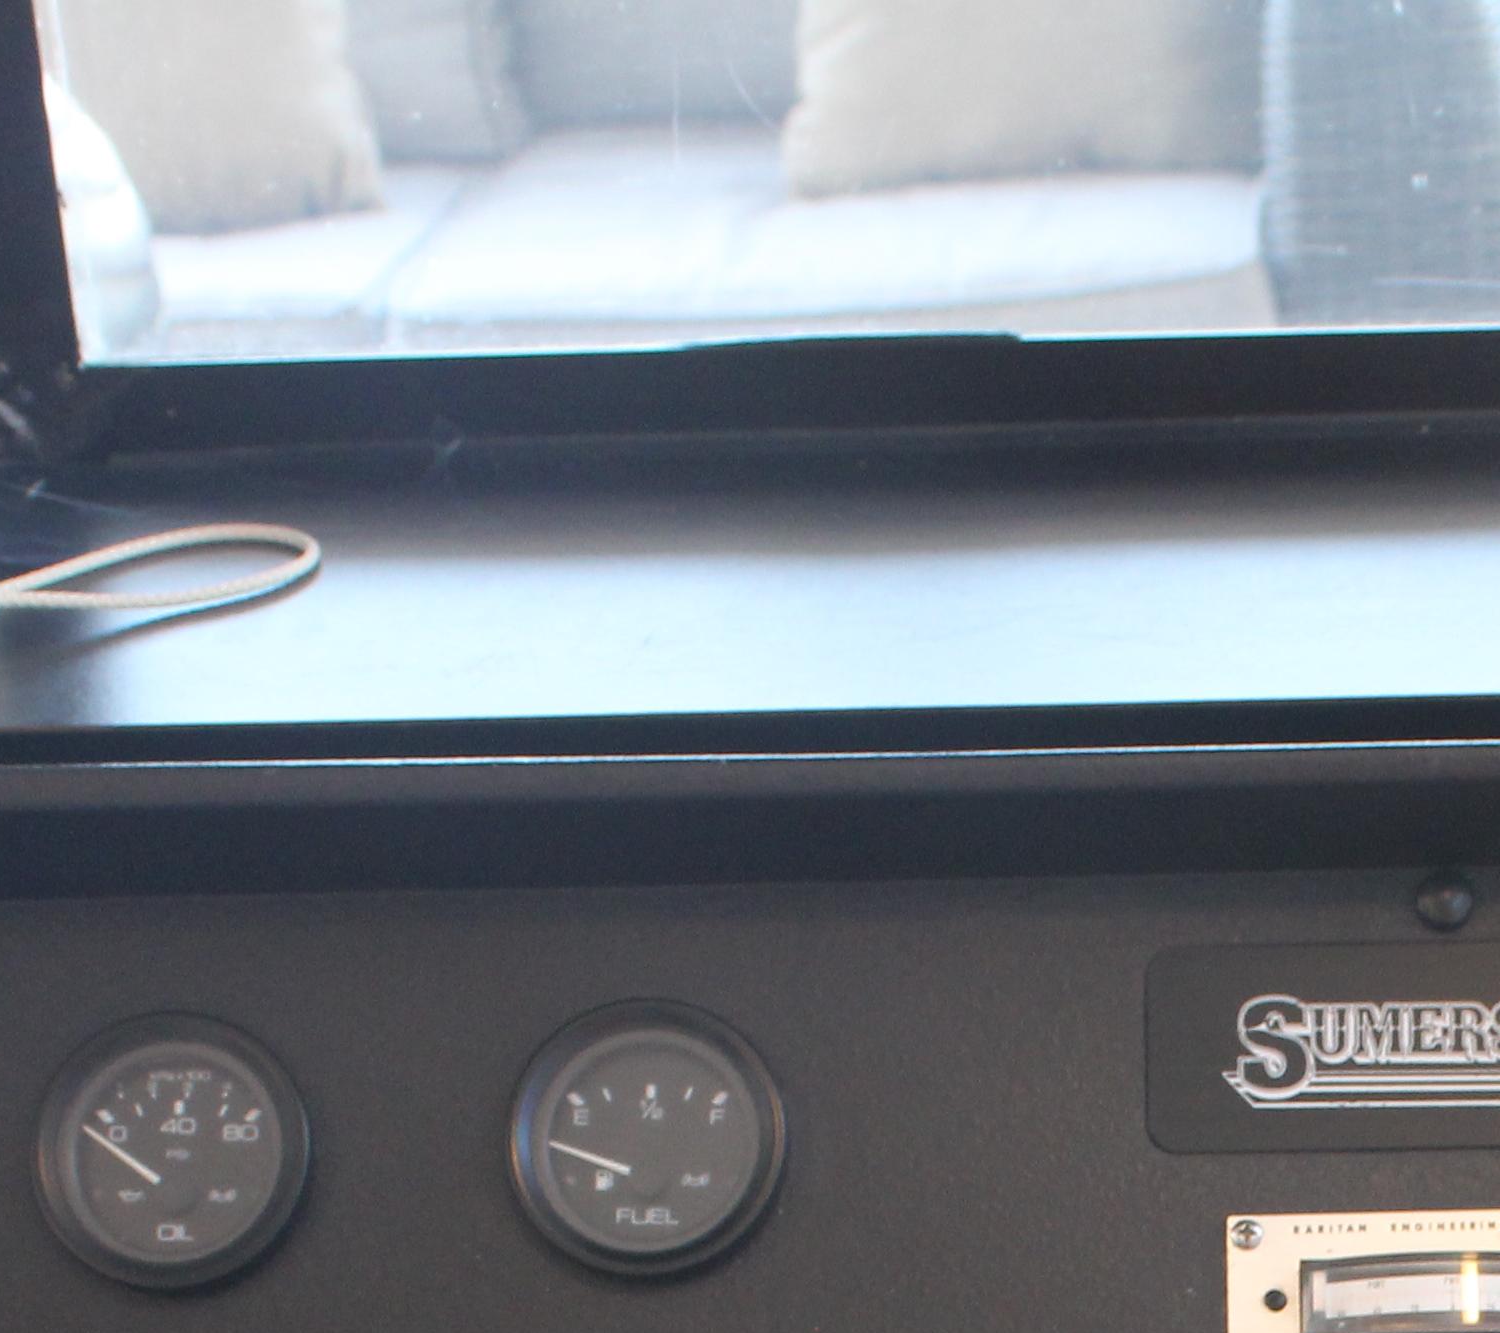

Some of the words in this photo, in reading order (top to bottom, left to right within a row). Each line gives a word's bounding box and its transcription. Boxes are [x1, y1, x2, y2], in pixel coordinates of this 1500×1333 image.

[573, 1108, 588, 1126] E
[709, 1108, 725, 1125] F
[110, 1125, 127, 1142] 0
[160, 1117, 196, 1135] 40
[222, 1124, 259, 1142] 80
[615, 1207, 679, 1226] FUEL
[156, 1224, 193, 1241] OIL
